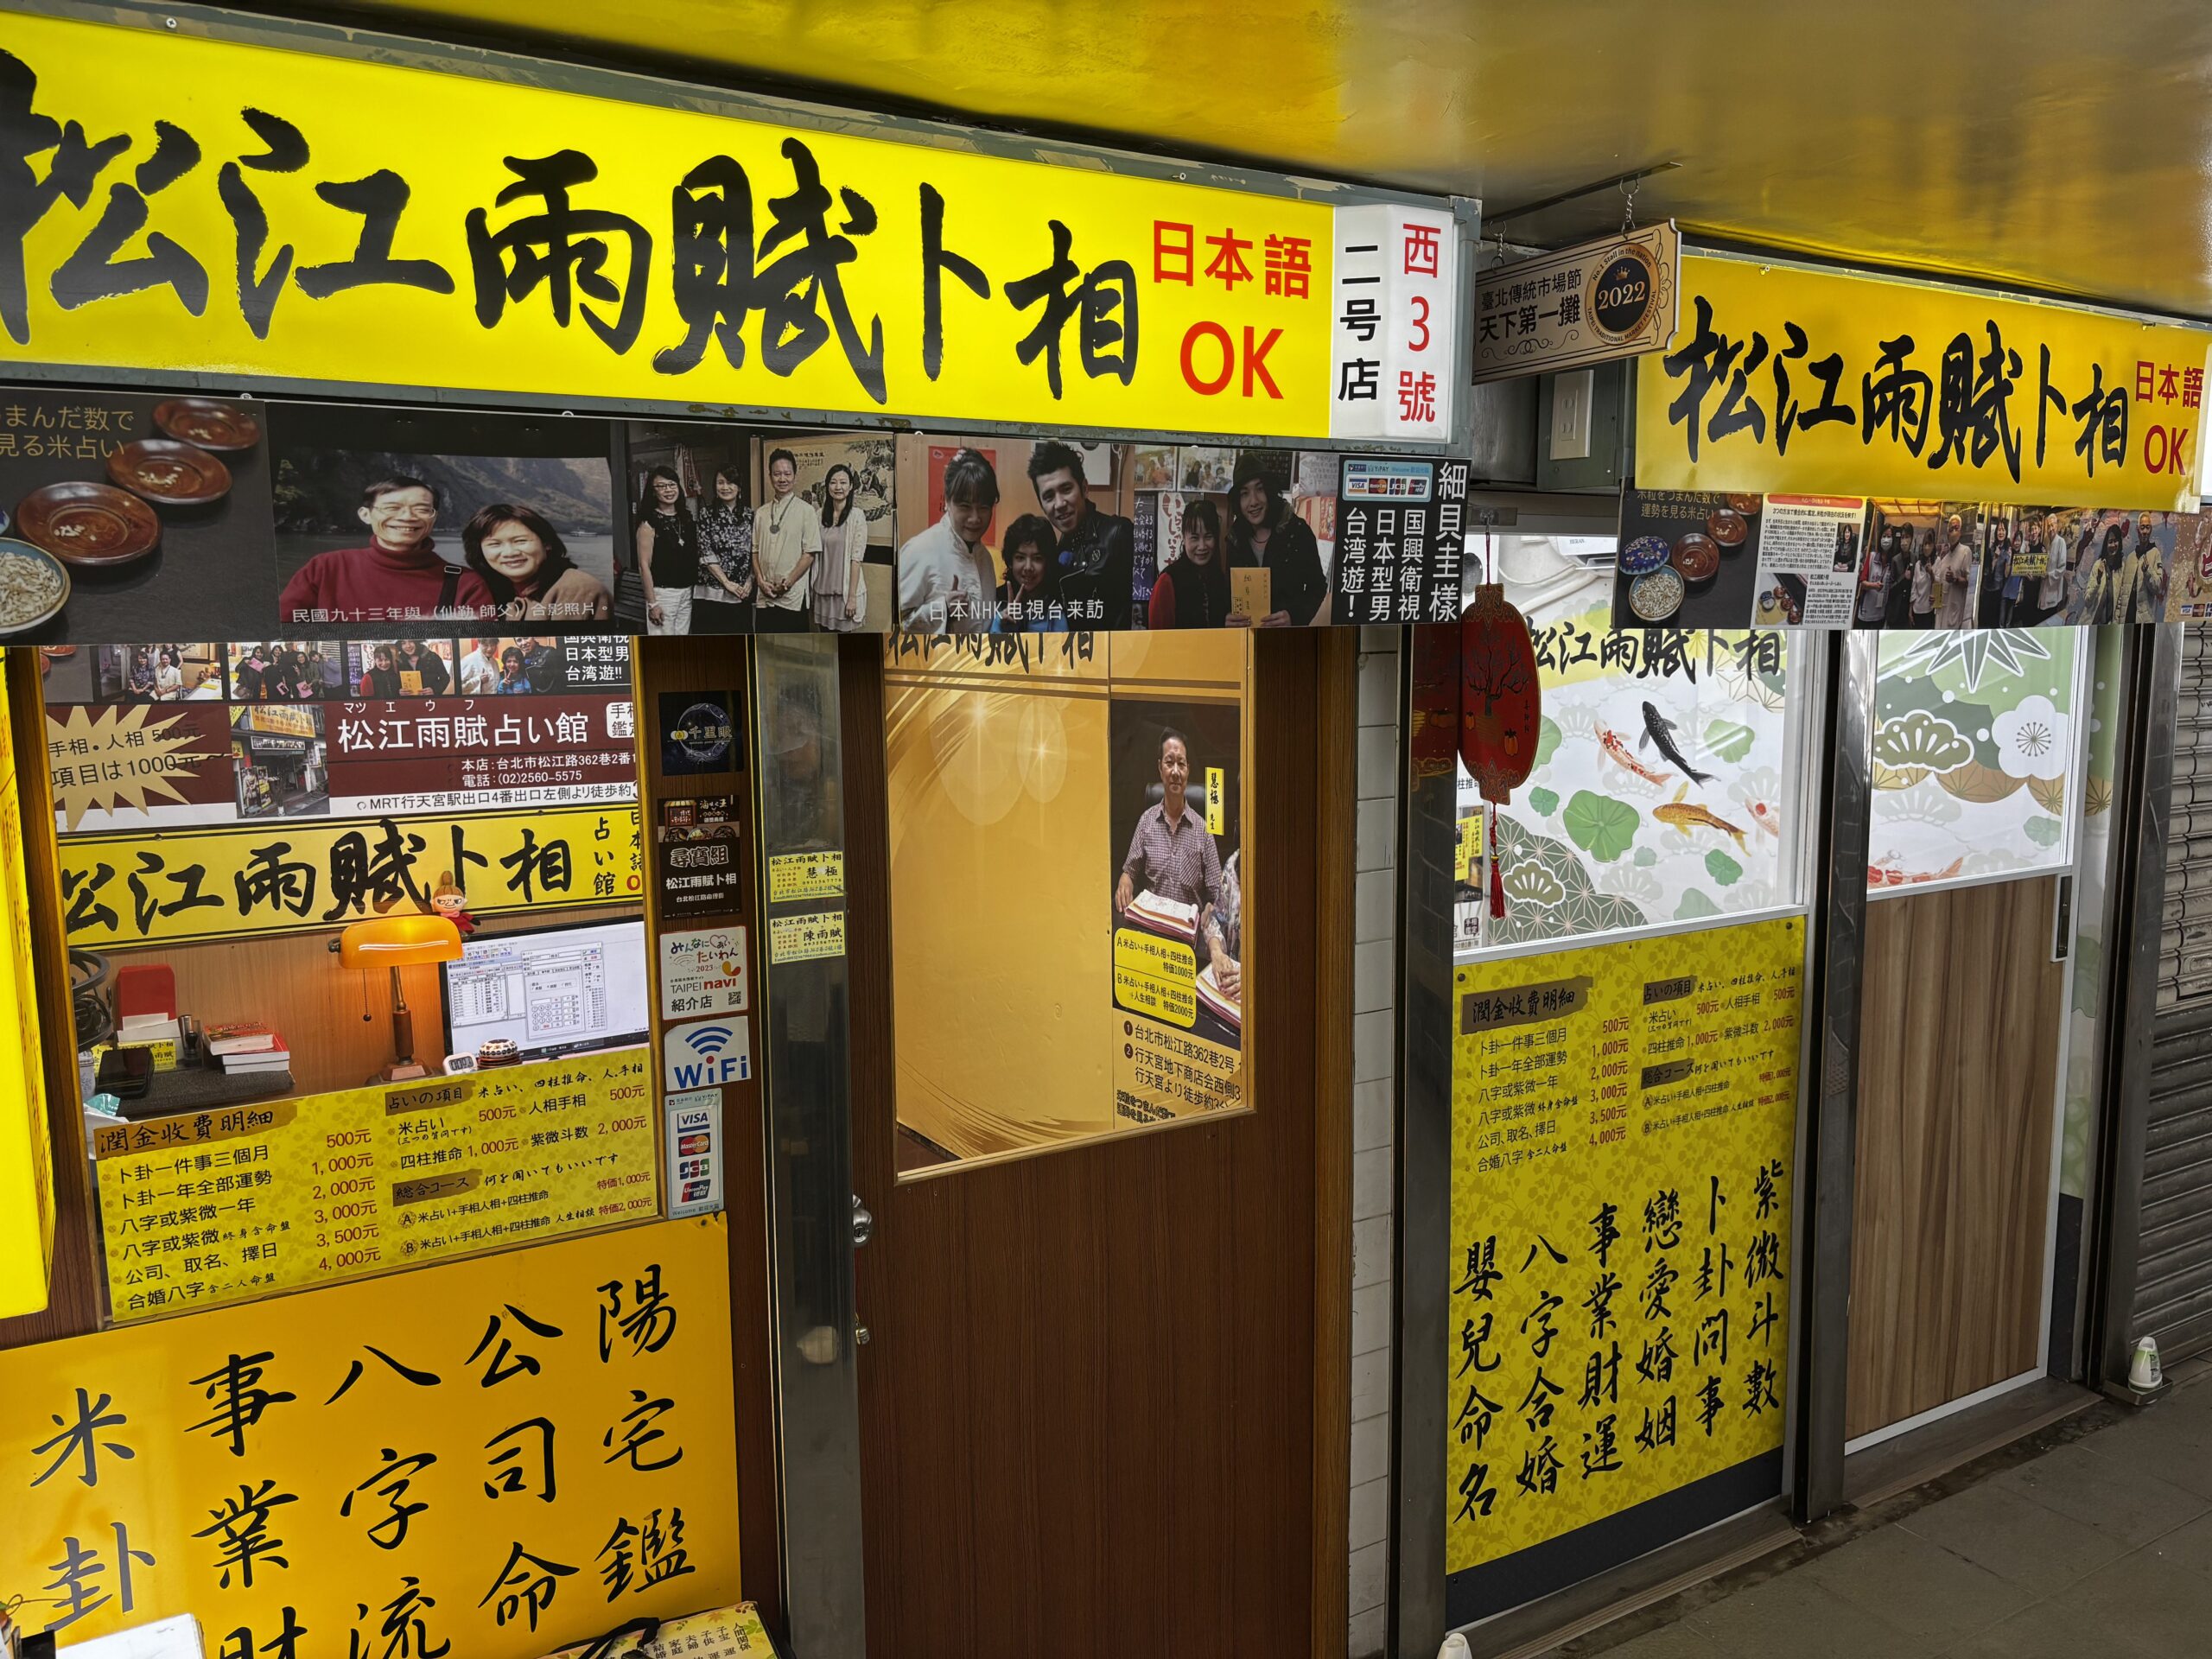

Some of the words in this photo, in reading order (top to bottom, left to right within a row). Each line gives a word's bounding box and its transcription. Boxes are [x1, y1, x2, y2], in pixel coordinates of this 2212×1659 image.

[0, 48, 1139, 404] 松江雨賦卜相
[1154, 220, 1312, 299] 日本語
[1481, 269, 1582, 312] 臺北傳統市場節
[1598, 282, 1645, 310] 2022
[1338, 245, 1381, 403] 二号店
[1397, 224, 1441, 423] 西3號
[1479, 294, 1581, 343] 天下第一攤
[1179, 321, 1285, 400] OK
[1664, 296, 2128, 483] 松江雨賦卜相
[2136, 359, 2202, 410] 日本語
[2144, 425, 2189, 476] OK
[1369, 509, 1395, 621] 日本型男
[1397, 509, 1426, 621] 国興衛視
[565, 646, 630, 663] 日本型男
[338, 712, 588, 753] 松江雨賦占い館
[689, 726, 733, 740] 千里眼
[594, 817, 615, 895] 占い館
[671, 845, 729, 868] 尋寶組
[772, 854, 842, 866] 松江雨賦卜相
[665, 873, 737, 890] 松江雨賦卜相
[772, 913, 842, 928] 松江雨賦卜相
[697, 948, 738, 963] たいわん
[1117, 937, 1122, 948] A
[671, 982, 702, 994] TAIPEI
[703, 978, 736, 990] navi
[1117, 974, 1122, 984] B
[1644, 980, 1691, 1001] 占いの項目
[671, 995, 713, 1012] 紹介店
[1472, 988, 1575, 1024] 潤金收費明細
[1649, 1008, 1677, 1024] 米占い
[1696, 999, 1719, 1015] 500元
[1726, 992, 1760, 1009] 人相手相
[1774, 986, 1796, 1001] 500元
[1481, 1027, 1567, 1057] 卜卦一件事三個月
[1603, 1016, 1630, 1034] 500元
[1648, 1036, 1685, 1054] 四柱推命
[674, 1055, 748, 1089] WiFi
[1480, 1050, 1568, 1080] 卜卦一年全部運勢
[389, 1087, 463, 1110] 占いの項目
[1478, 1075, 1559, 1104] 八字或紫微一年
[398, 1116, 445, 1135] 米占い
[479, 1104, 517, 1122] 500元
[529, 1093, 587, 1115] 人相手相
[609, 1084, 645, 1102] 500元
[681, 1113, 709, 1125] VISA
[1478, 1101, 1535, 1128] 八字或紫微
[100, 1110, 274, 1154] 潤金收費明細
[400, 1147, 463, 1170] 四柱推命
[531, 1125, 589, 1147] 紫微斗数
[119, 1145, 269, 1185] 卜卦一件事三個月
[327, 1128, 372, 1148] 500元
[680, 1160, 709, 1177] JCB
[1478, 1150, 1523, 1173] 合婚八字
[122, 1169, 272, 1210] 卜卦一年全部運勢
[396, 1177, 469, 1200] 総合コース
[120, 1198, 256, 1236] 八字或紫微一年
[122, 1229, 219, 1261] 八字或紫微
[128, 1281, 205, 1312] 合婚八字
[1693, 1175, 1734, 1437] 卜卦問事
[1741, 1158, 1785, 1419] 紫微斗數
[1578, 1203, 1624, 1480] 事業財運
[1635, 1188, 1681, 1456] 戀愛婚姻
[1452, 1235, 1503, 1524] 嬰兒命名
[594, 1262, 696, 1604] 陽宅鑑
[465, 1303, 580, 1632] 公司命
[29, 1387, 156, 1632] 米卦
